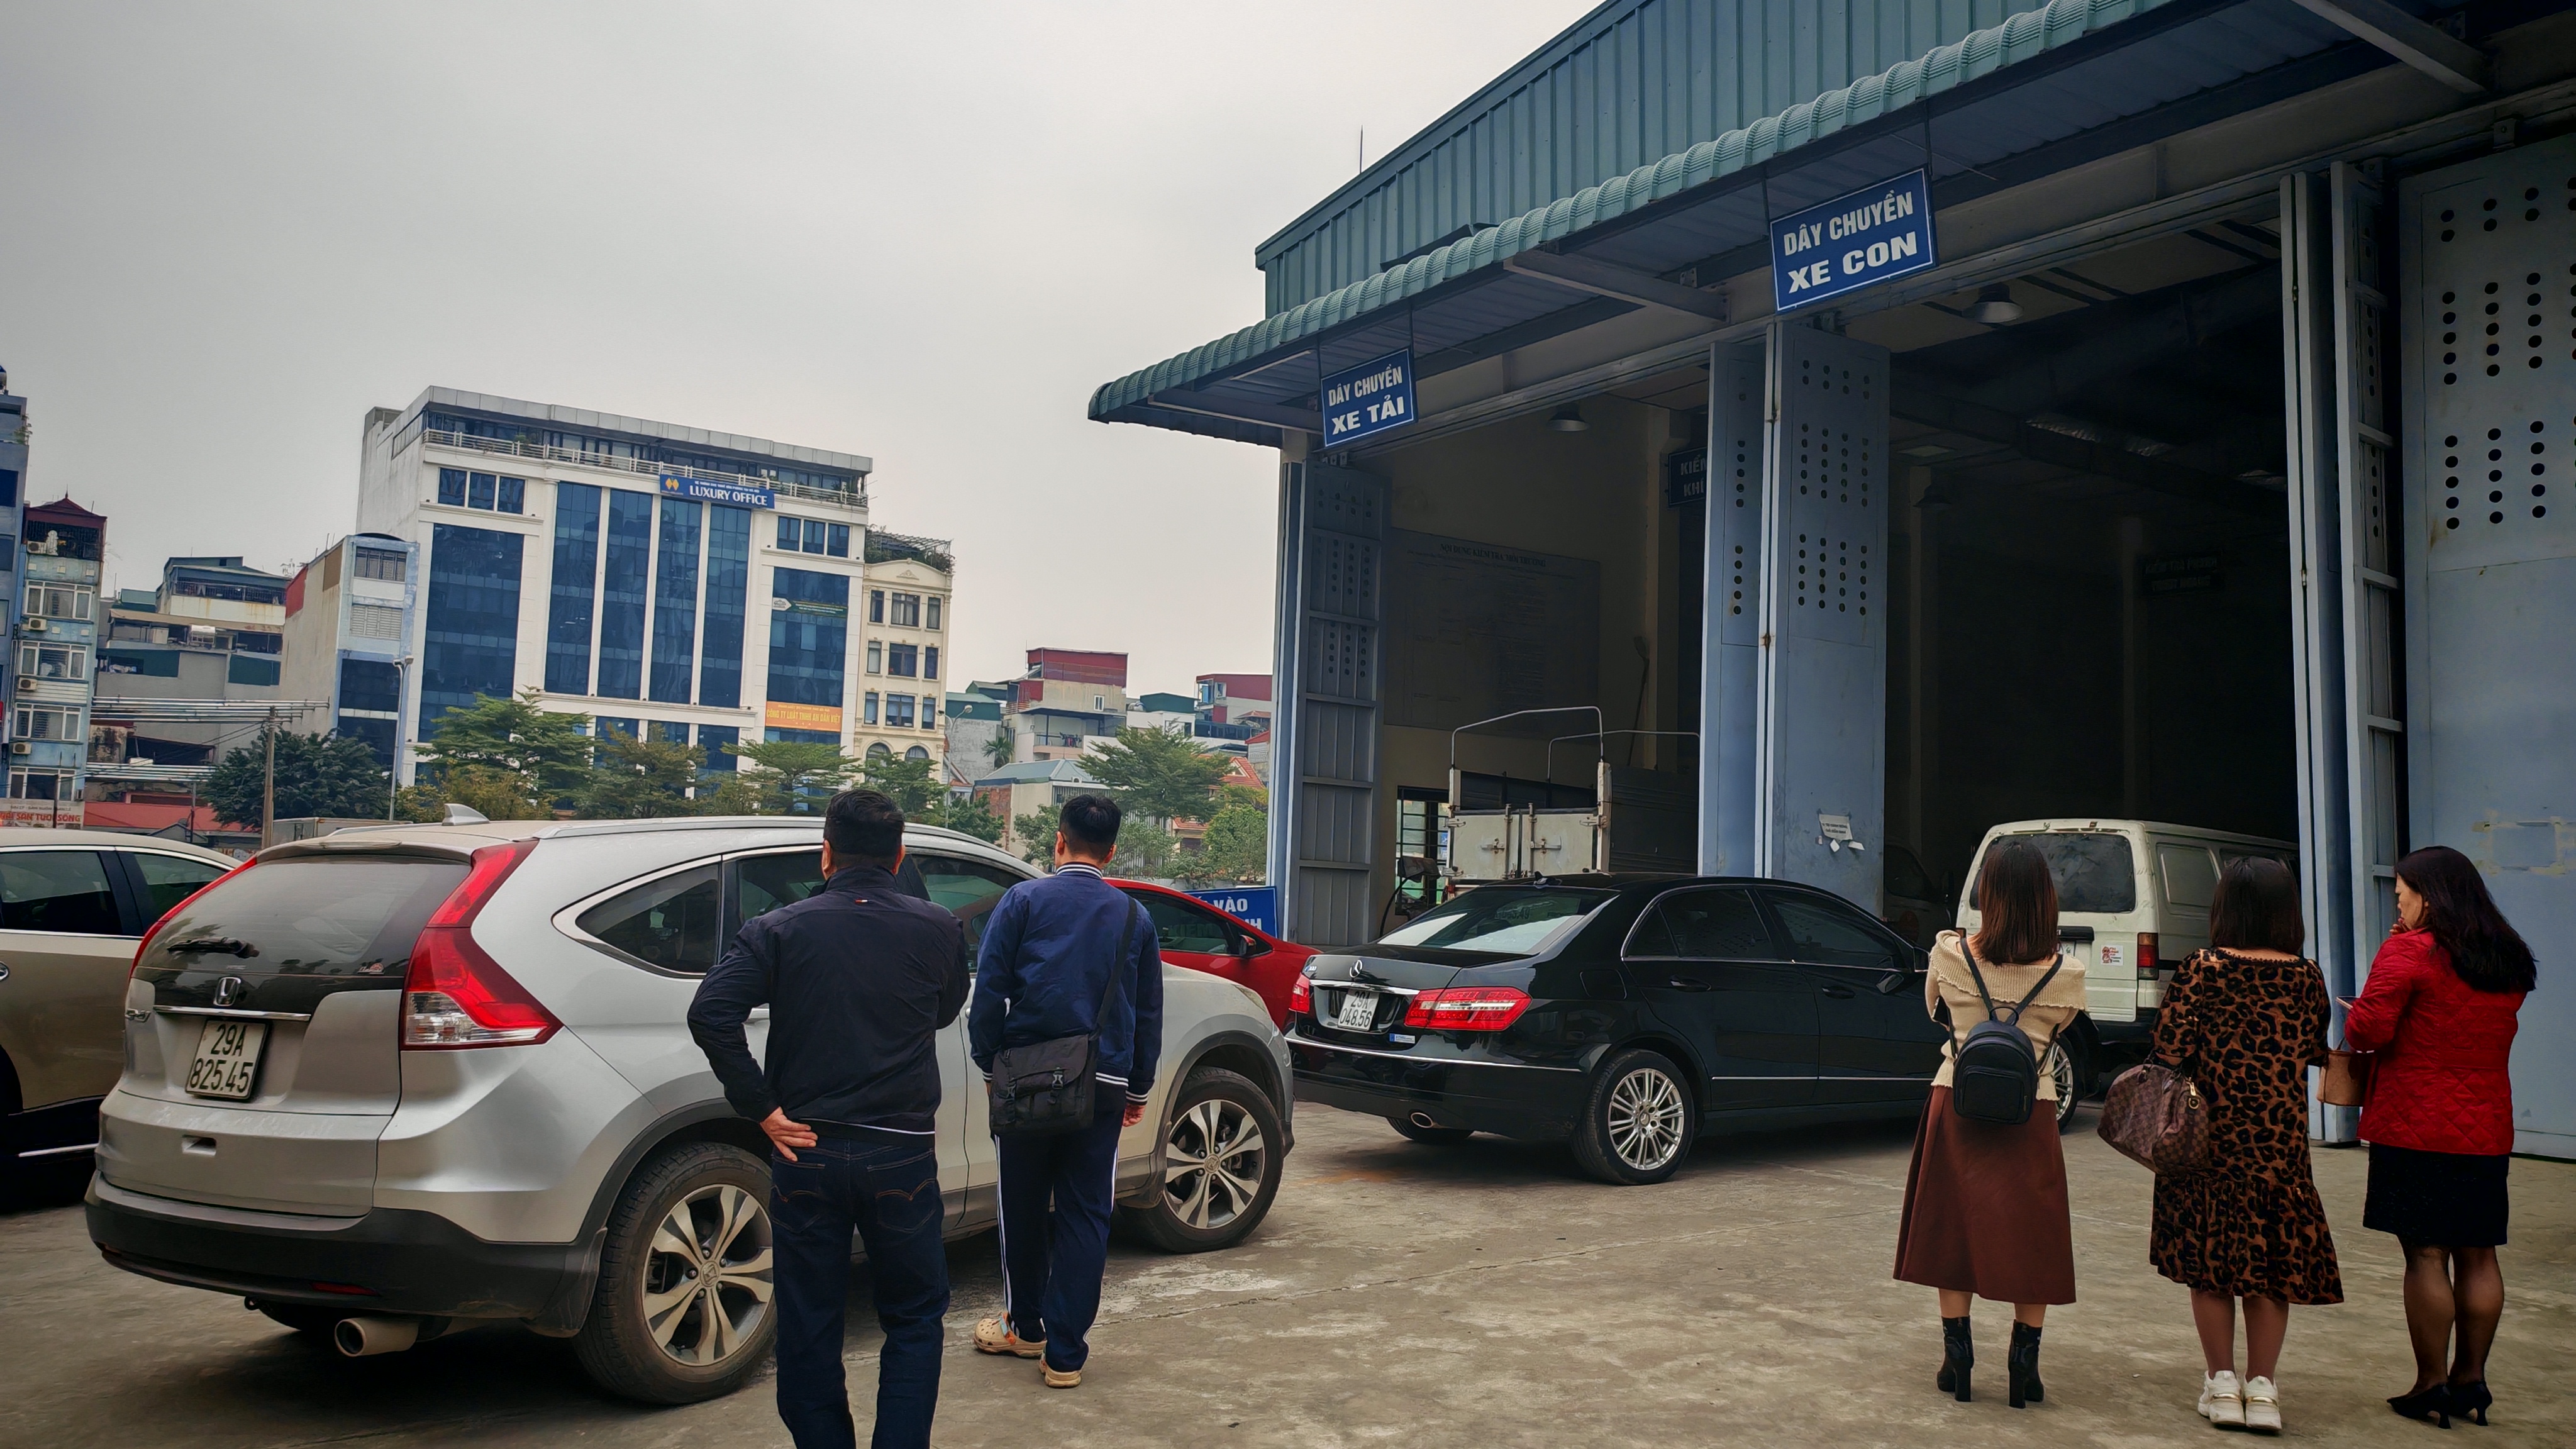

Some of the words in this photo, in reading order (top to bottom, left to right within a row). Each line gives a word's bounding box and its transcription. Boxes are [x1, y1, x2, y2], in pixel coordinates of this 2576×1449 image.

[1784, 222, 1822, 257] DÂY
[1829, 189, 1914, 241] CHUYỀN
[1787, 259, 1831, 294] XE
[1843, 230, 1918, 275] CON
[1328, 382, 1351, 407] DÂY
[1354, 363, 1402, 398] CHUYỀN
[1331, 410, 1361, 435] XE
[1367, 394, 1405, 423] TẢI
[690, 485, 731, 501] LUXURY
[733, 491, 767, 506] OFFICE
[1684, 477, 1704, 497] KHÍ
[1213, 896, 1248, 913] VÀO
[1351, 991, 1370, 1008] 29A
[1340, 1008, 1372, 1028] 048.56
[211, 1023, 247, 1057] 29A
[190, 1058, 253, 1093] 825.45
